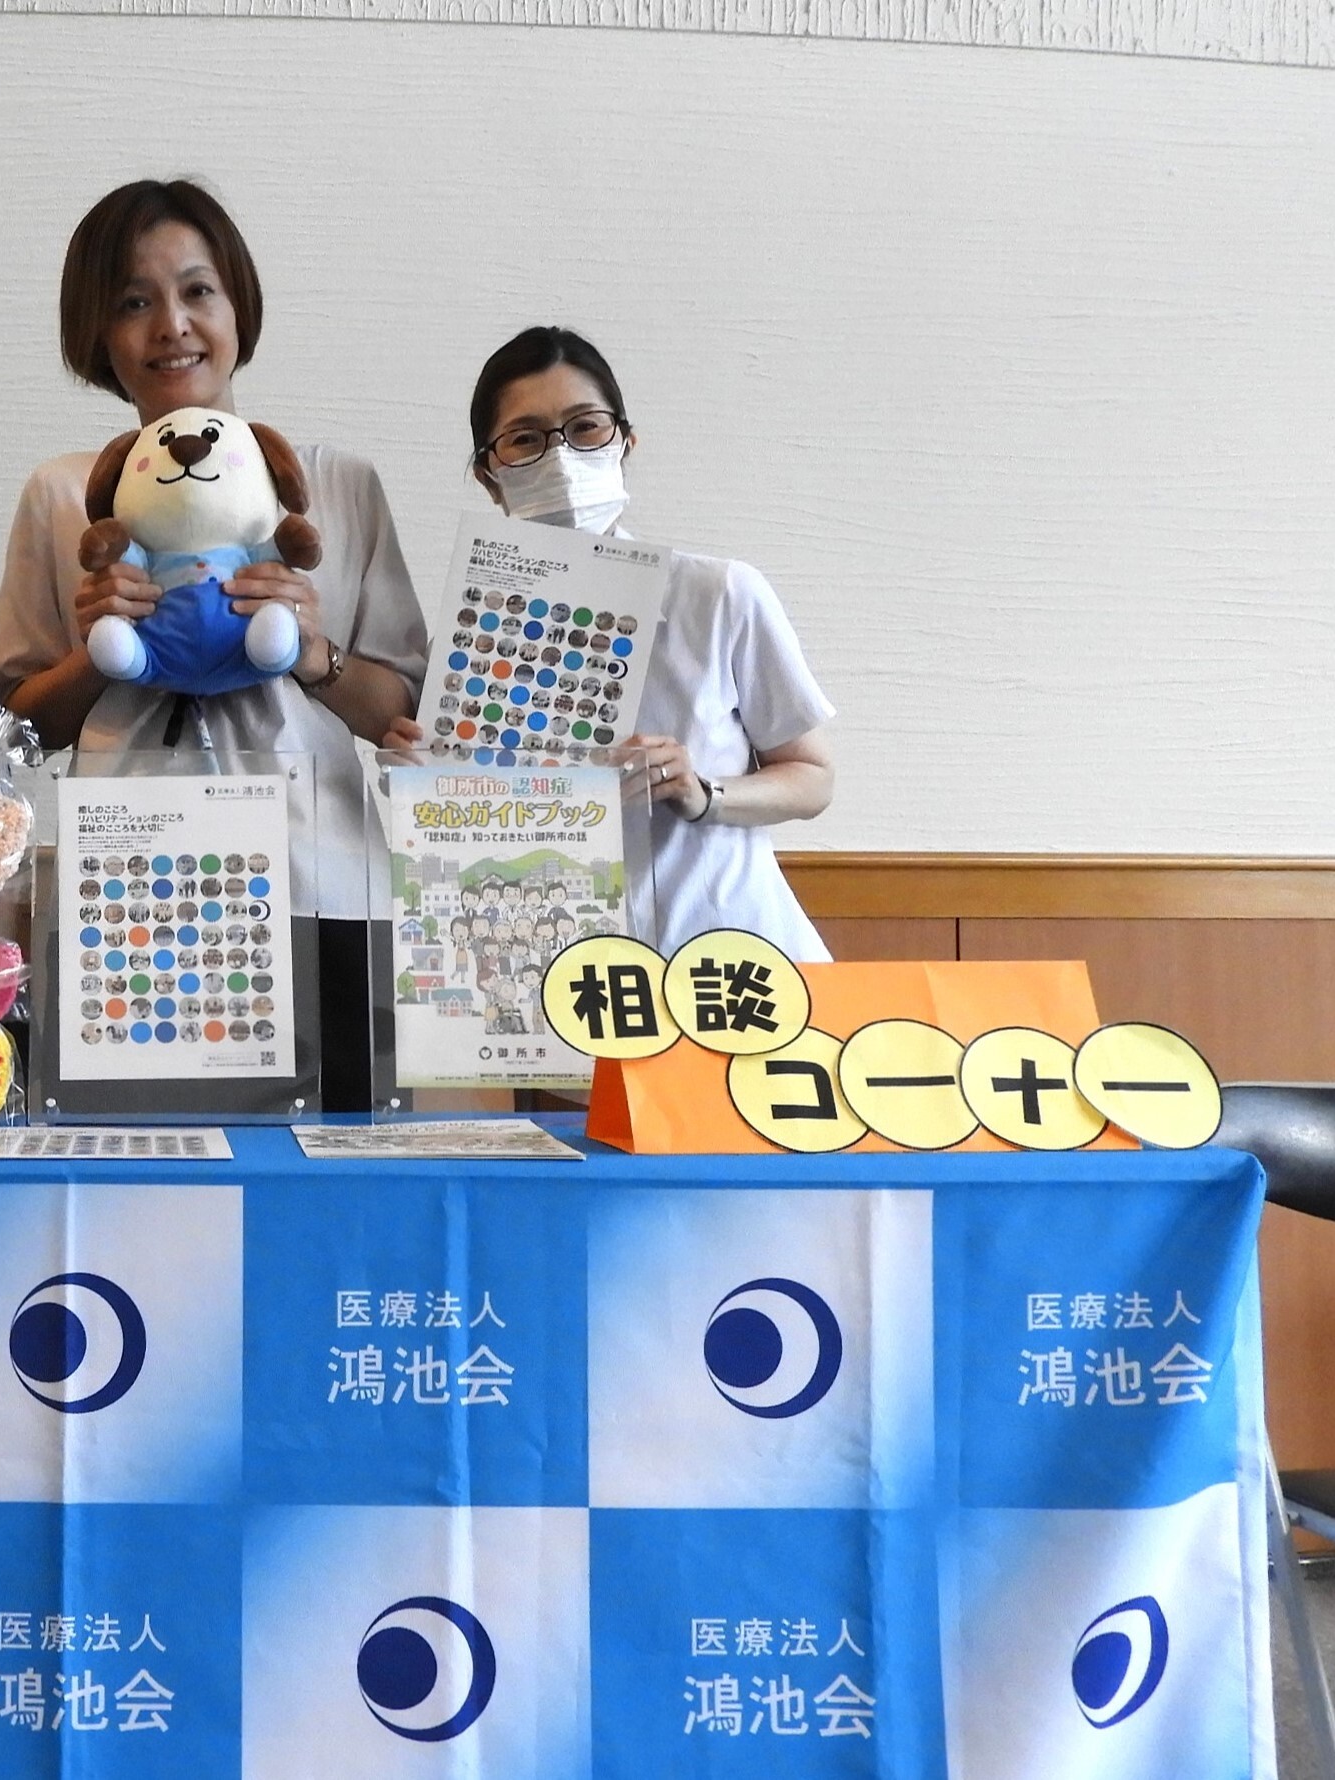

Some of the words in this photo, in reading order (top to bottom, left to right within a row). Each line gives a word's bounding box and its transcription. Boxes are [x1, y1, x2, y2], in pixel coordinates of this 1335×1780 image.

[470, 547, 570, 573] リハビリテーションのこころ
[77, 805, 129, 815] 癒しのこころ
[77, 813, 185, 824] リハビリテーションのこころ
[78, 823, 165, 833] 福祉のこころを大切に
[413, 800, 607, 828] 安心ガイドブック
[335, 1290, 507, 1330] 医療法人
[1026, 1291, 1201, 1332] 医療法人
[328, 1344, 516, 1406] 鴻池会
[1019, 1343, 1213, 1407] 鴻池会
[690, 1617, 865, 1658] 医療法人
[683, 1675, 876, 1740] 鴻池会
